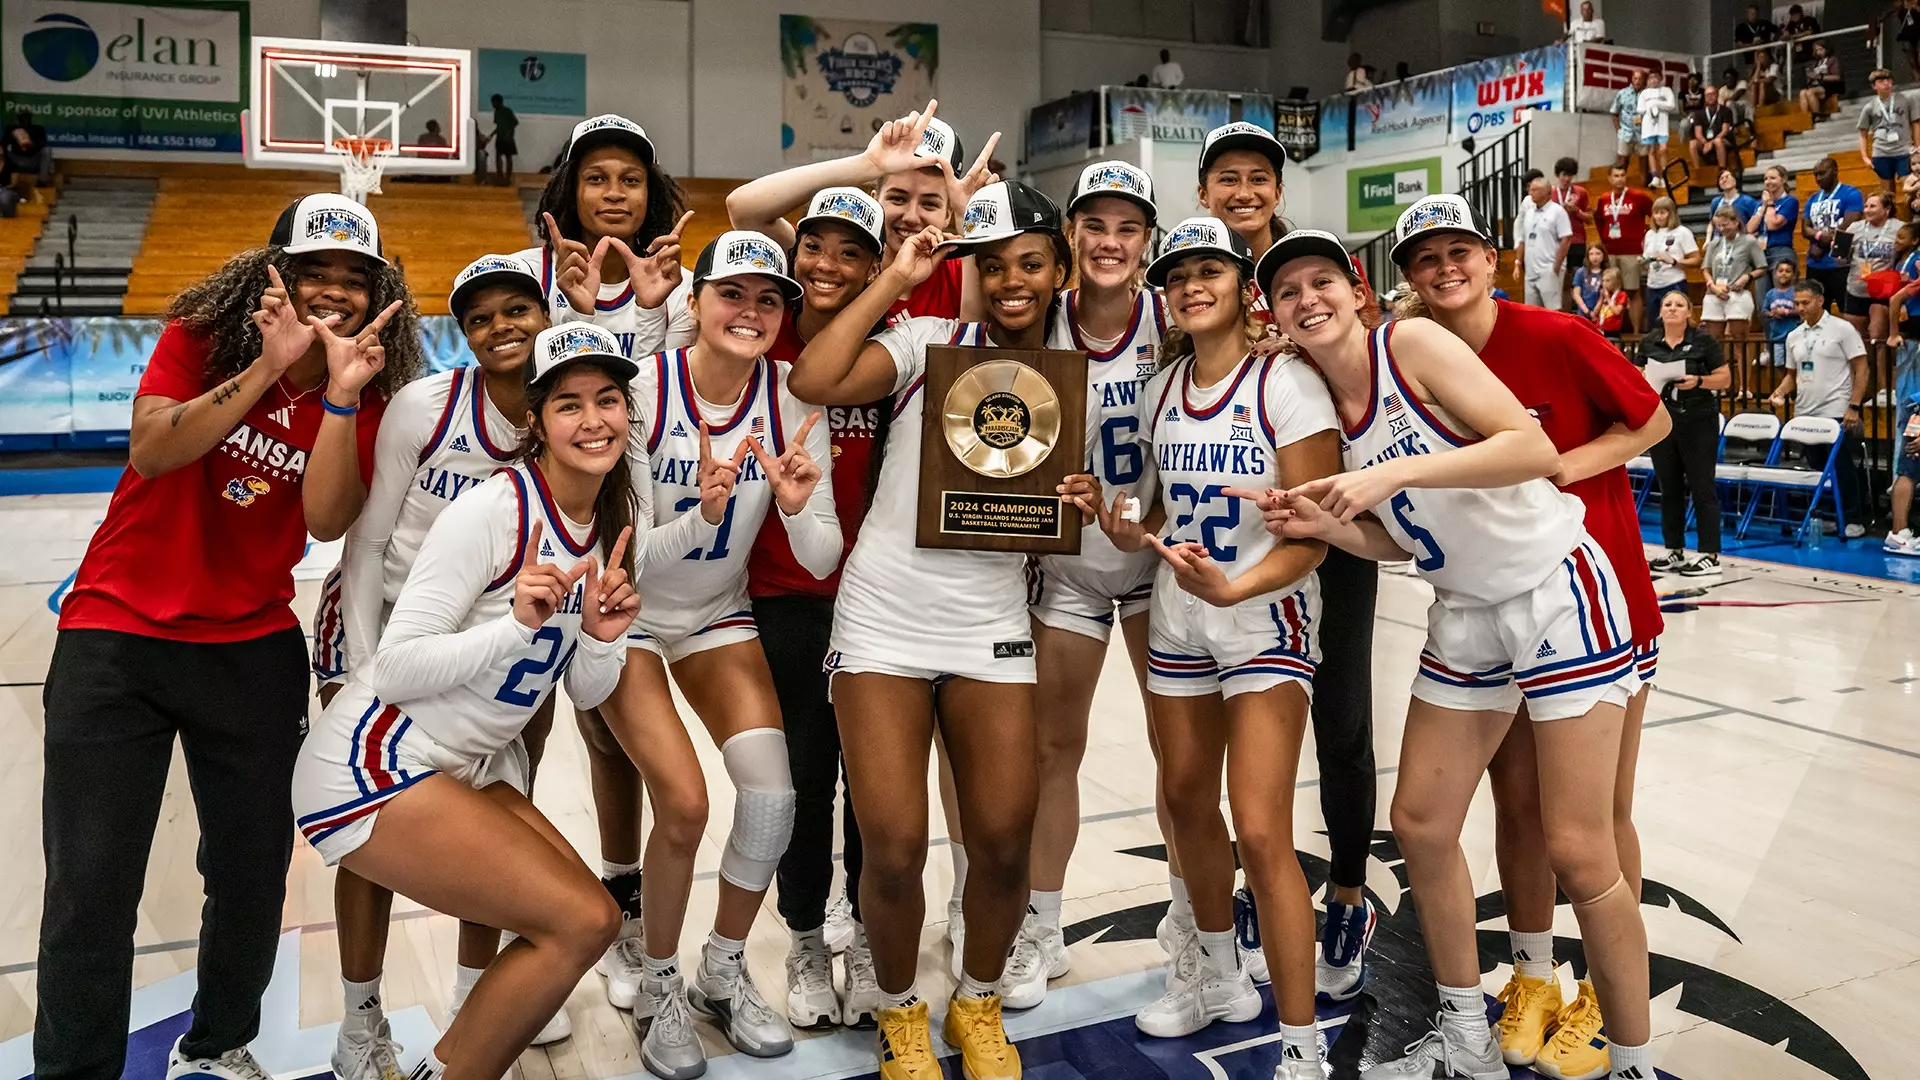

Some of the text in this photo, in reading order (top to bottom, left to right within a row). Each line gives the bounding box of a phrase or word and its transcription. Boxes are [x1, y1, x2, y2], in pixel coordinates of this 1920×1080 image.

[106, 18, 221, 67] elan
[107, 71, 221, 85] INSURANCE GROUP
[1477, 68, 1545, 107] WTJX
[57, 104, 117, 118] sponsor
[122, 105, 138, 118] of
[142, 107, 169, 120] UVI
[173, 108, 238, 123] Athletics
[1278, 113, 1315, 128] ARMY
[1483, 111, 1506, 128] PBS
[47, 132, 125, 145] w.elan.insure
[1152, 126, 1205, 140] REALTY
[1278, 132, 1316, 145] GUARD
[1397, 180, 1423, 194] Bank
[829, 407, 879, 430] SAS
[222, 424, 306, 475] ANSA
[220, 445, 298, 483] ASKETBA
[1158, 443, 1266, 476] JAYHAWKS
[950, 501, 1054, 516] 2024 CHAMPIONS
[961, 519, 1041, 530] BASKETBALL TOURNAMENT
[1163, 483, 1241, 562] 22
